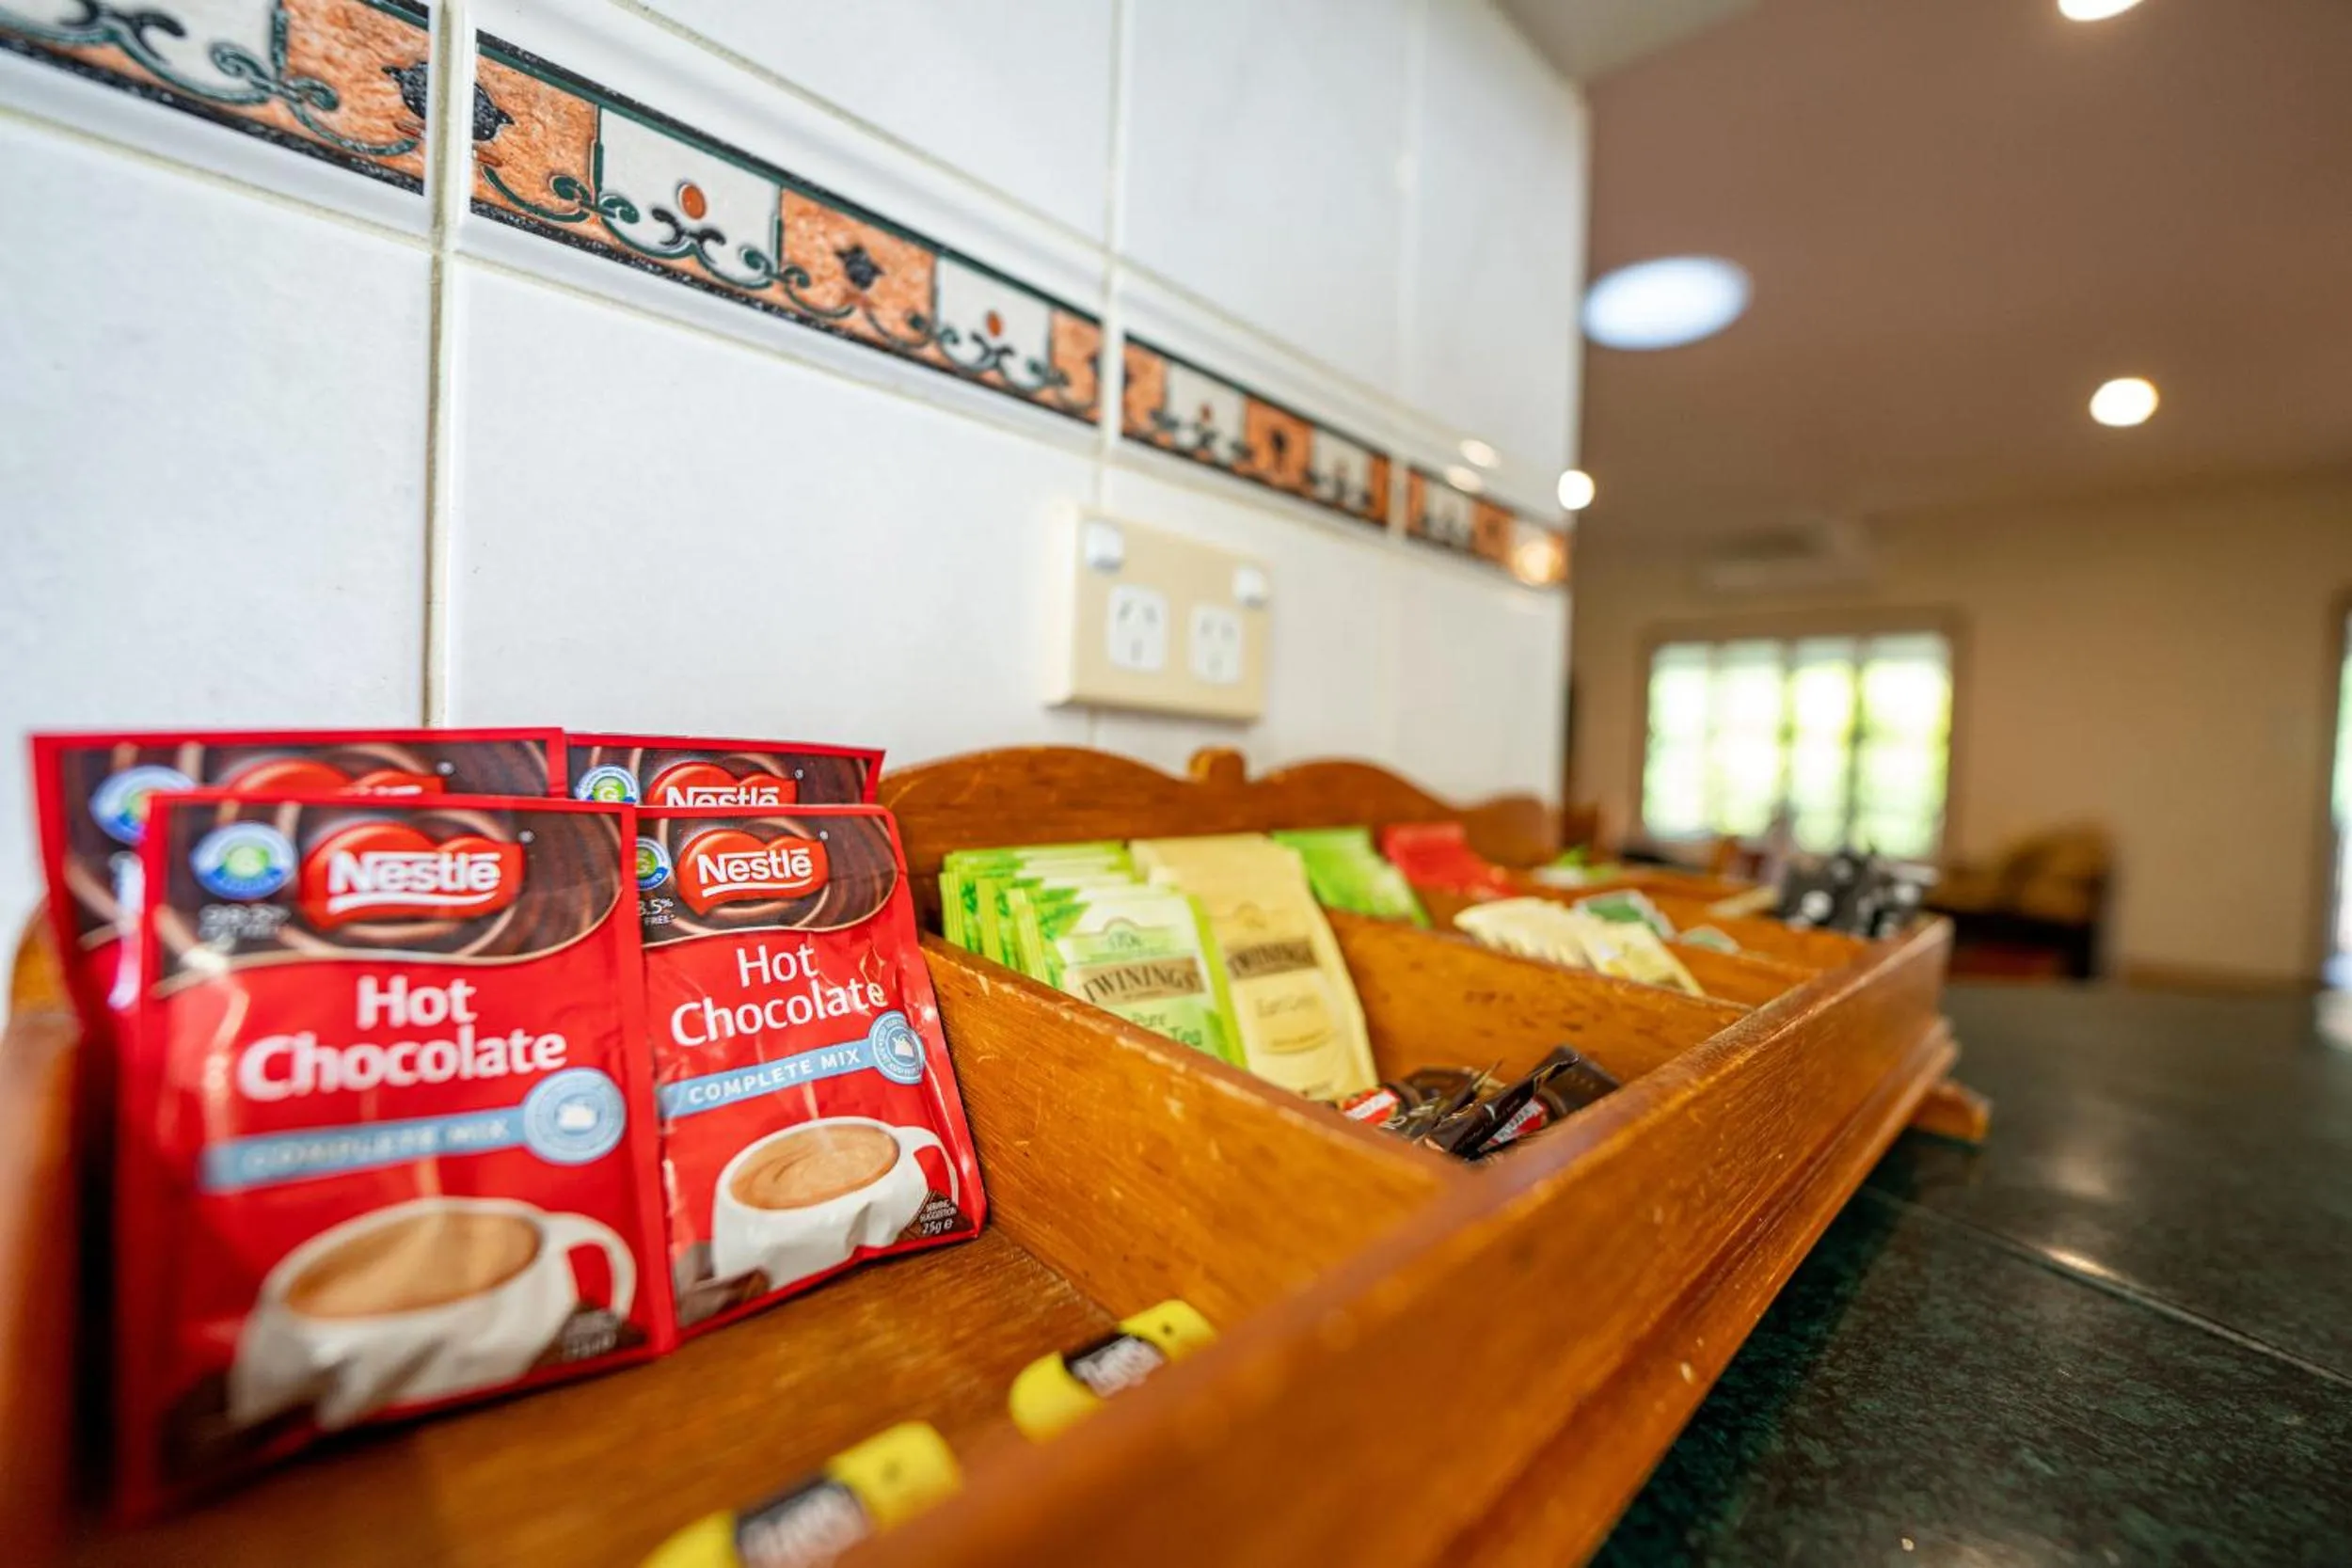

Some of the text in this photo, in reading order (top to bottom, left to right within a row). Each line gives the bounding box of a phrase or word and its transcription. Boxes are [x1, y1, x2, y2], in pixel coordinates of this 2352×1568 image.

[327, 850, 501, 894] Nestlé
[697, 848, 813, 884] Nestlé
[736, 943, 816, 988] Hot
[1083, 964, 1200, 1003] TWININGS
[357, 976, 477, 1029] Hot
[670, 976, 889, 1048] Chocolate
[238, 1027, 567, 1101] Chocolate
[689, 1048, 862, 1104] COMPLETE MIX
